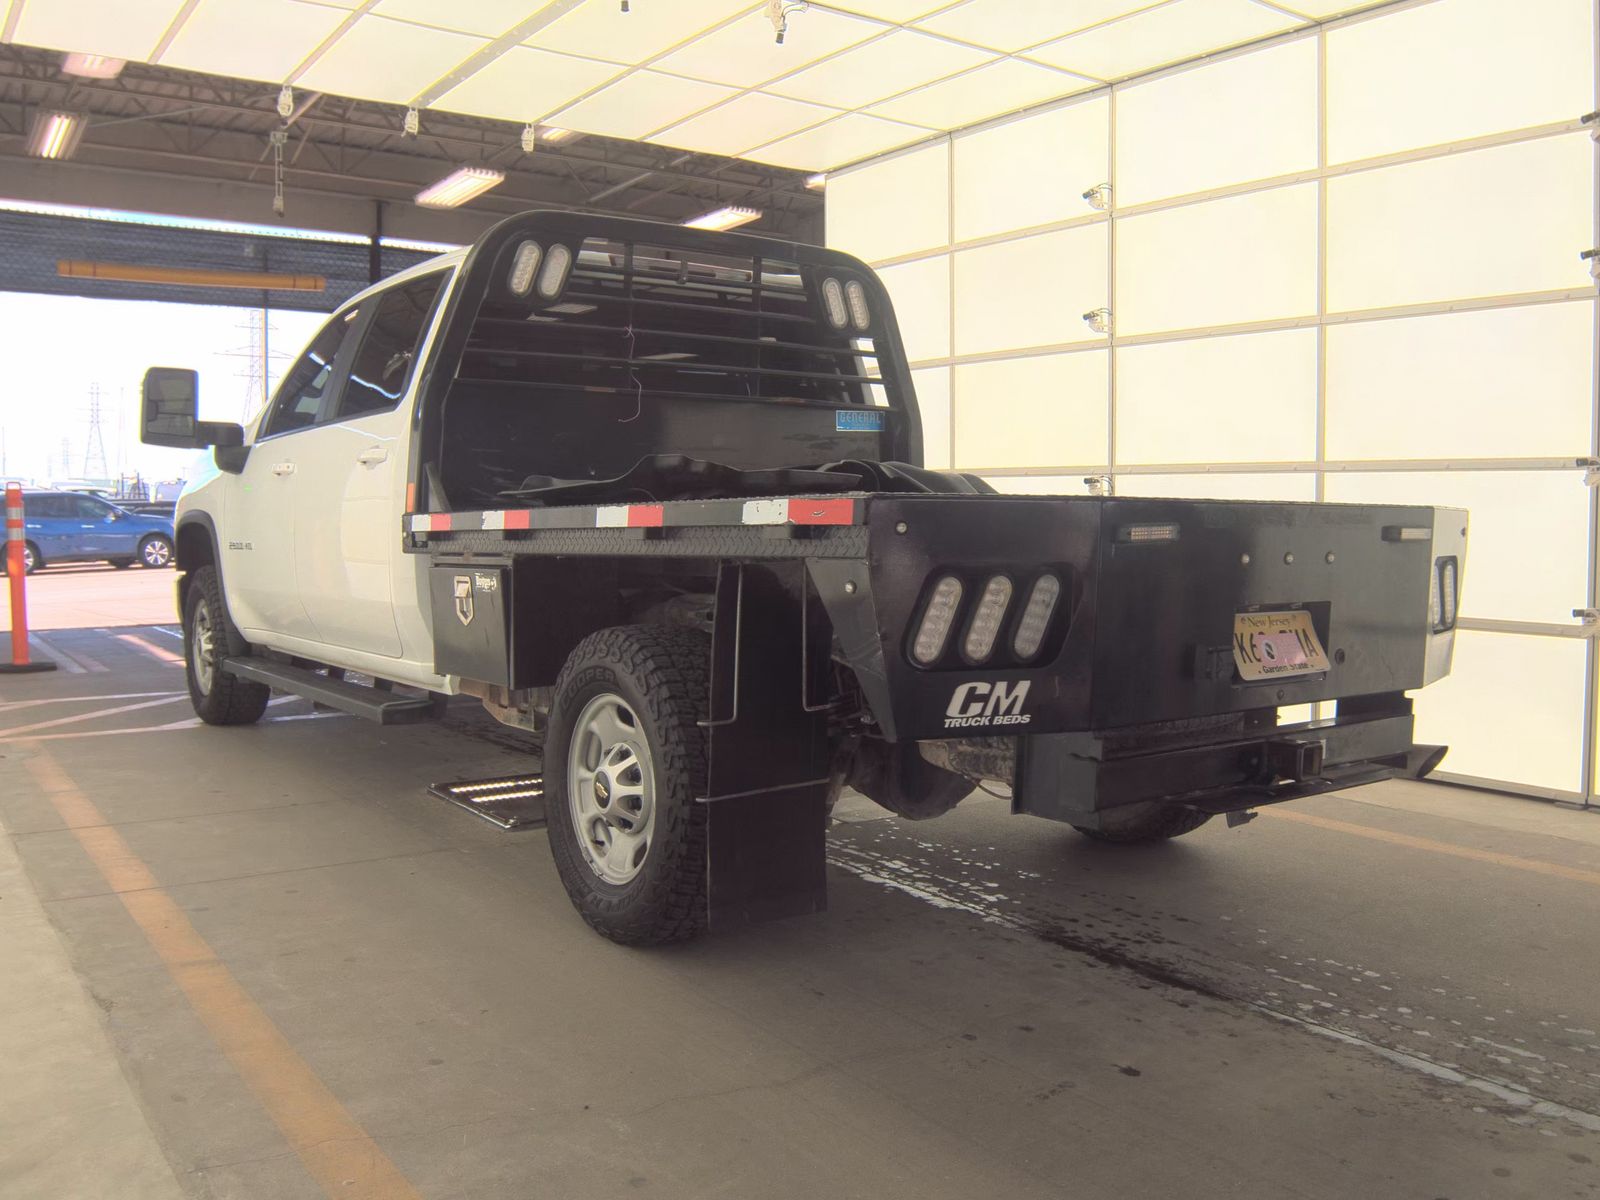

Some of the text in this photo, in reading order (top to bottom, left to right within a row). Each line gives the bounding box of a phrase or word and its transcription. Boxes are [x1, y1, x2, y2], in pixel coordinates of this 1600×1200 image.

[1247, 615, 1290, 628] New Jersey
[1262, 662, 1309, 674] Garden State
[560, 667, 616, 710] COOPER
[945, 680, 1031, 717] CM
[944, 714, 1031, 728] TRUCK BEDS
